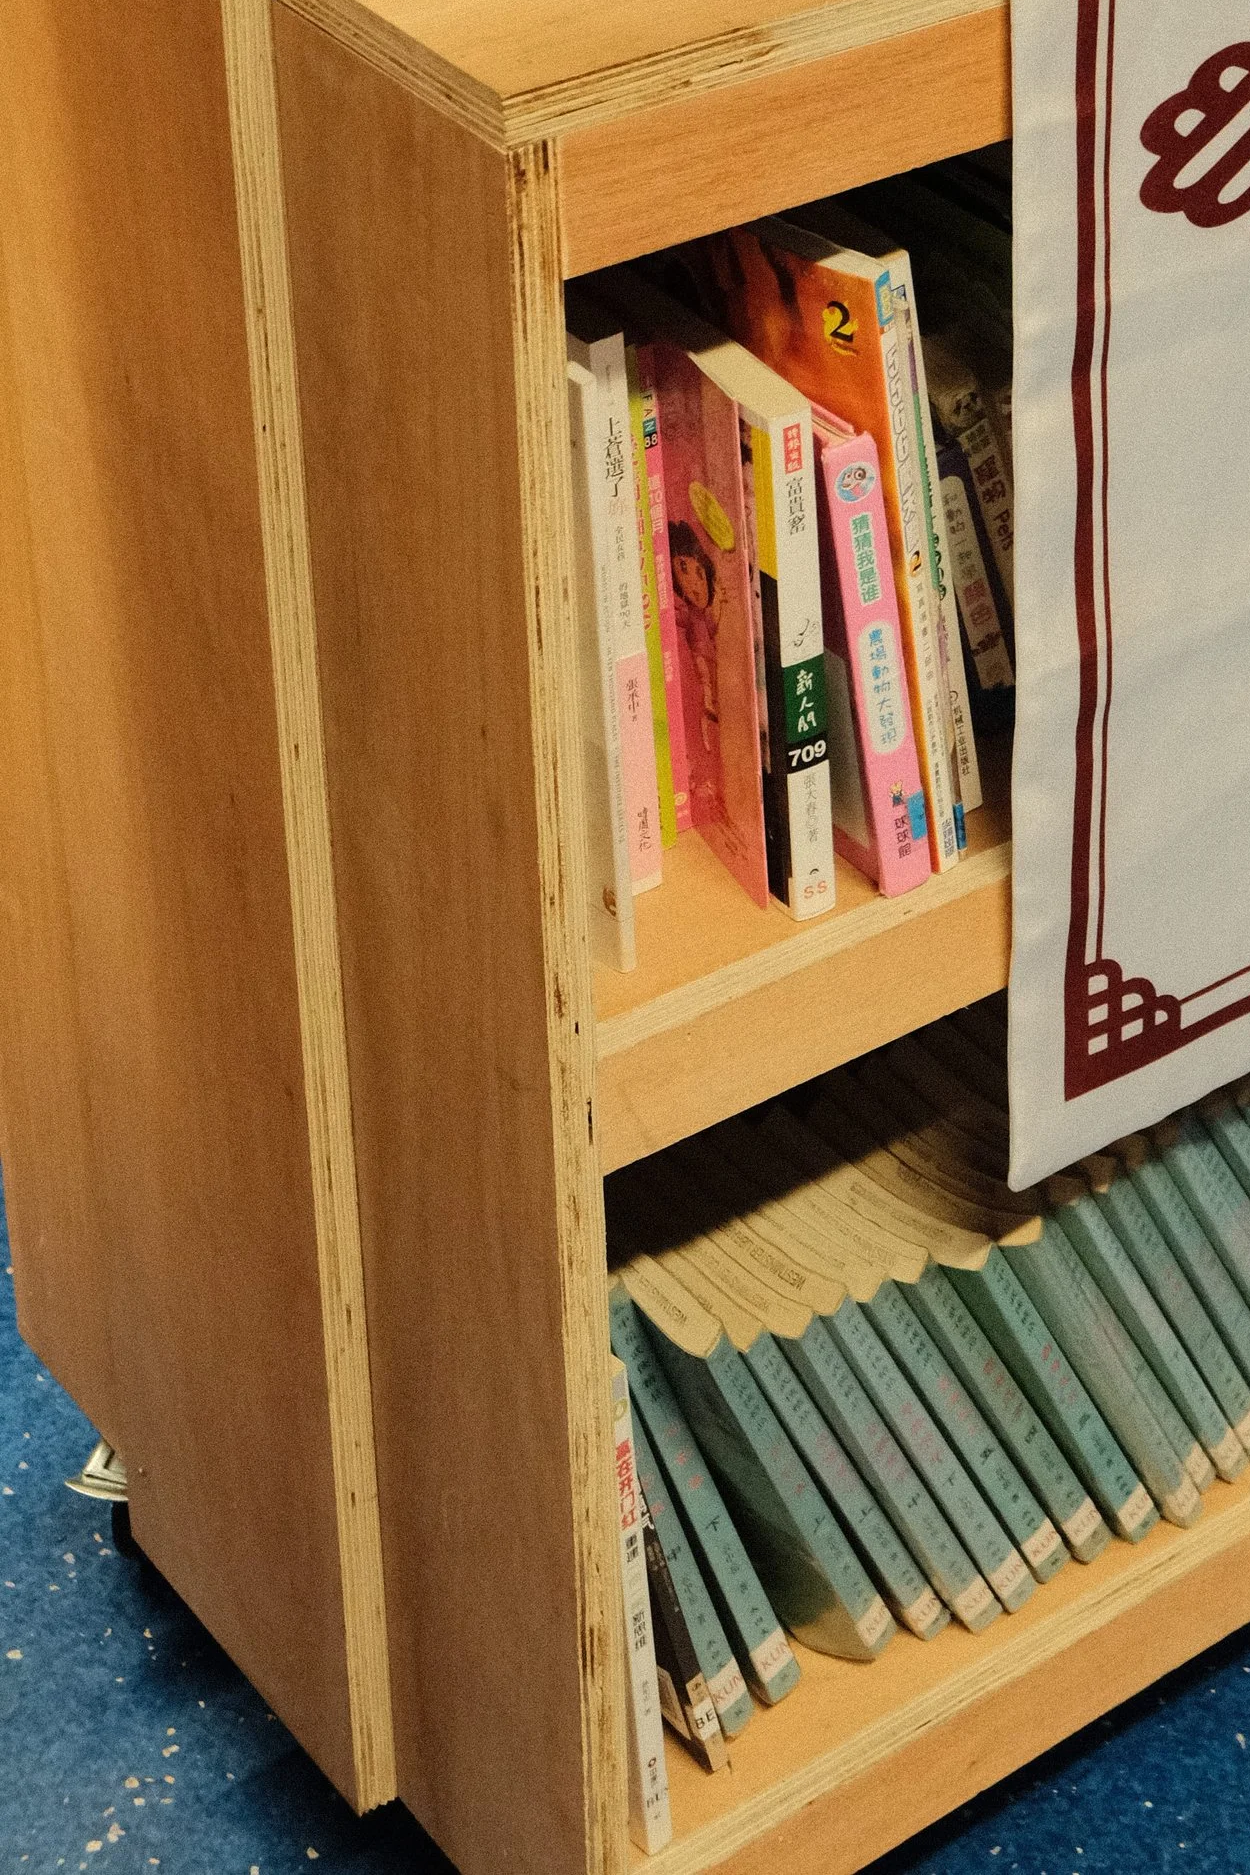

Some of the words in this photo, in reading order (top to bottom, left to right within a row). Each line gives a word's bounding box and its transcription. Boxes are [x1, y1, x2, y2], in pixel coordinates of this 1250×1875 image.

[827, 301, 856, 344] 2
[909, 550, 923, 576] 2
[787, 739, 827, 768] 709
[616, 1437, 637, 1530] 赢在开门红
